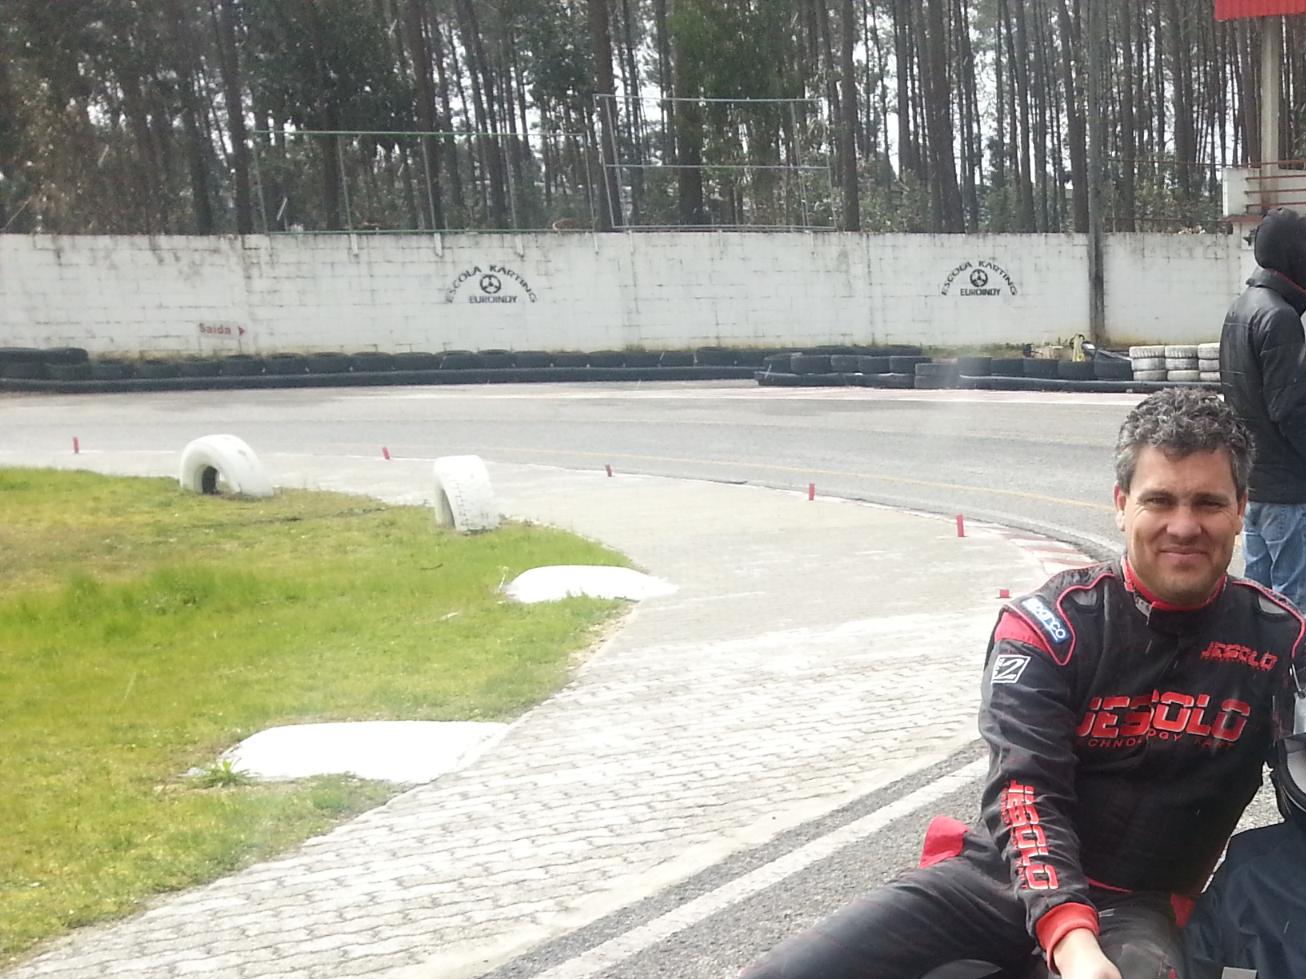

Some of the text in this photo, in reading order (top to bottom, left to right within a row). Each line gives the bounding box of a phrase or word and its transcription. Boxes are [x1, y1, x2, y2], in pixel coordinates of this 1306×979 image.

[445, 264, 538, 303] ESCOLA KARTING
[941, 260, 1018, 296] ESCOLA KARTING
[959, 288, 1001, 296] EUROINDY
[469, 295, 518, 304] EUROINDY
[1076, 690, 1250, 742] JESOLO
